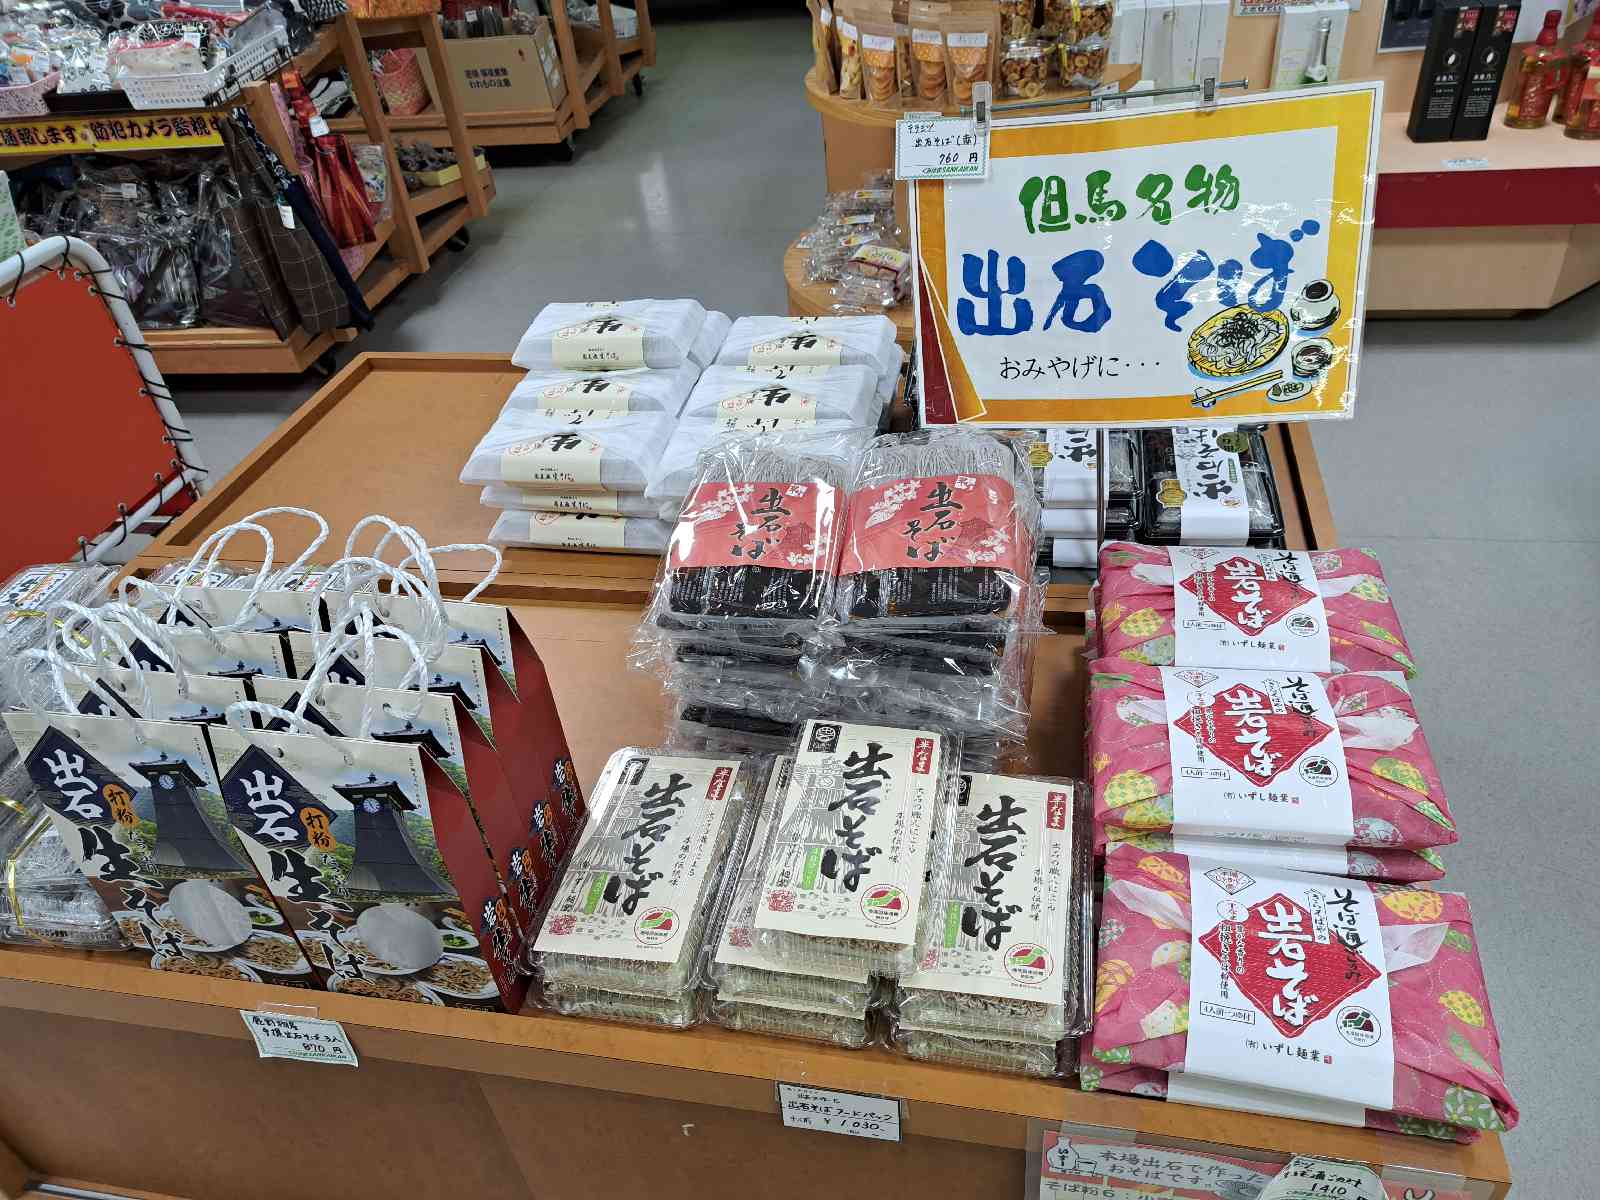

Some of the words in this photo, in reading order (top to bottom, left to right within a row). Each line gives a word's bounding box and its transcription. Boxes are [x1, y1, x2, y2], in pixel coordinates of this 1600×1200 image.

[968, 152, 978, 163] 円
[1019, 163, 1241, 234] 但馬名物
[43, 749, 104, 820] 出石
[240, 769, 300, 843] 出石
